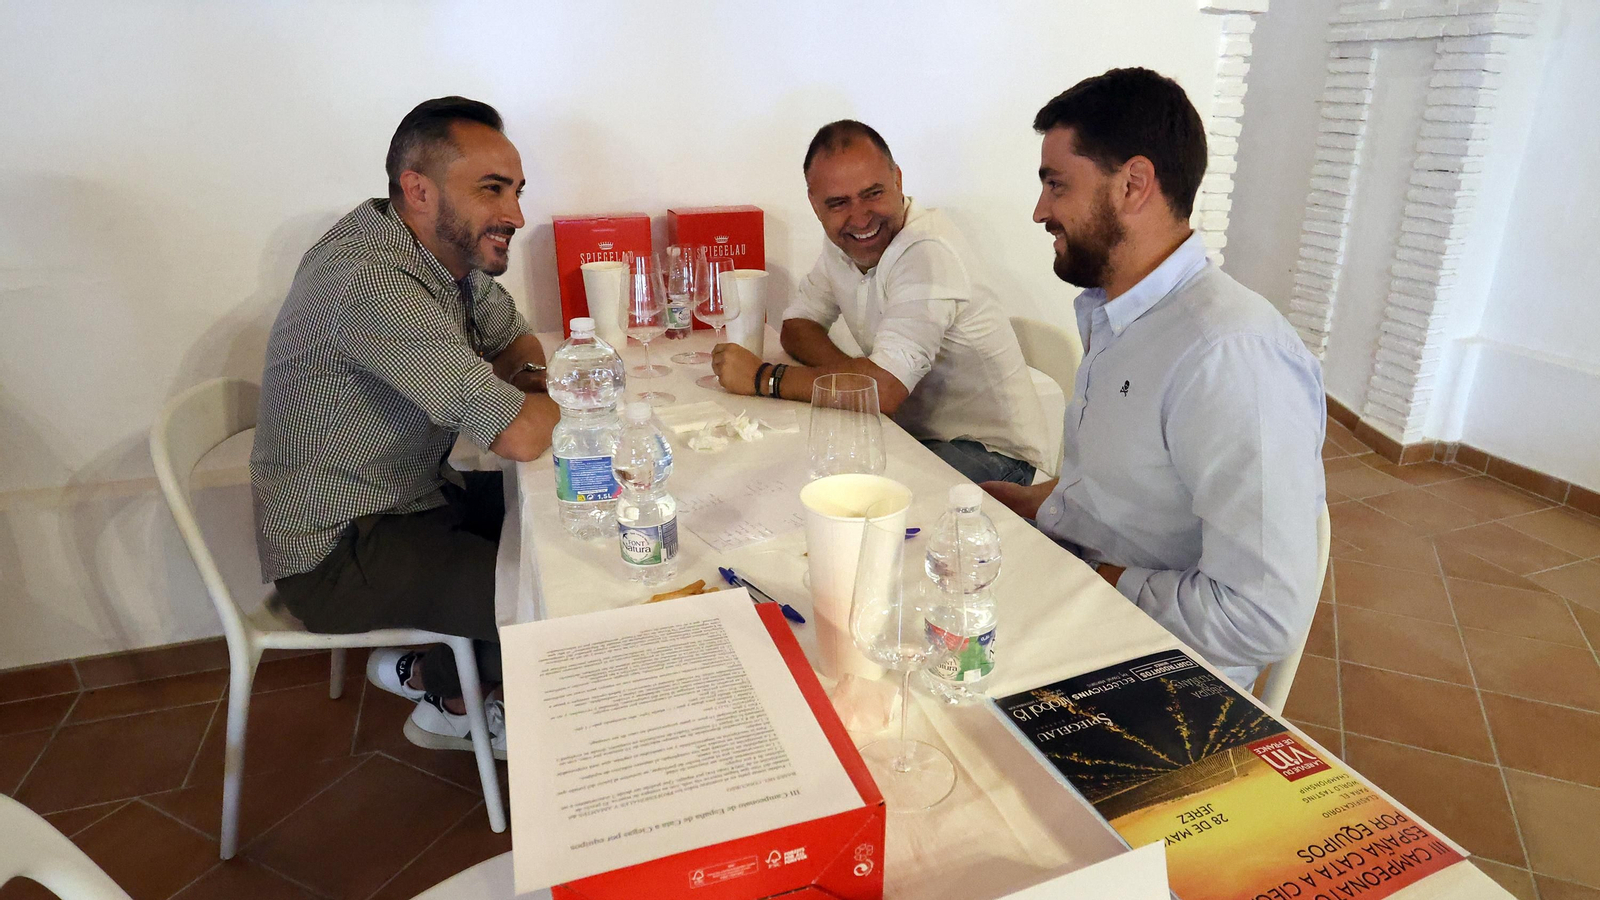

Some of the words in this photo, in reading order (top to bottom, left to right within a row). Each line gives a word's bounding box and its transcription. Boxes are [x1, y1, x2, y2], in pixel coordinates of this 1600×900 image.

[697, 244, 746, 257] SPIEGELAU
[1037, 712, 1113, 742] SPIEGELAU
[1253, 741, 1285, 755] FRANCE
[1282, 738, 1295, 746] DE
[1282, 769, 1294, 777] DU
[1300, 773, 1350, 794] CHAMPIONSHIP
[1334, 780, 1358, 791] WORLD
[1302, 788, 1334, 804] TASTING
[1349, 787, 1369, 797] PARA
[737, 791, 788, 809] Campeonato
[1322, 794, 1379, 819] CLASIFICATORIO
[683, 815, 694, 823] de
[694, 807, 725, 820] España
[1176, 803, 1214, 824] JEREZ
[1211, 813, 1229, 825] 28
[1369, 811, 1407, 831] POR
[661, 818, 681, 829] Cata
[1191, 820, 1212, 833] DE
[606, 832, 621, 842] por
[623, 824, 653, 839] Ciegas
[1164, 828, 1193, 847] MAY
[569, 836, 605, 852] equipos
[1297, 823, 1374, 863] EQUIPOS
[1361, 825, 1429, 858] ESPAÑA
[1428, 840, 1451, 856] III
[1314, 852, 1365, 880] CATA
[1299, 873, 1317, 888] A
